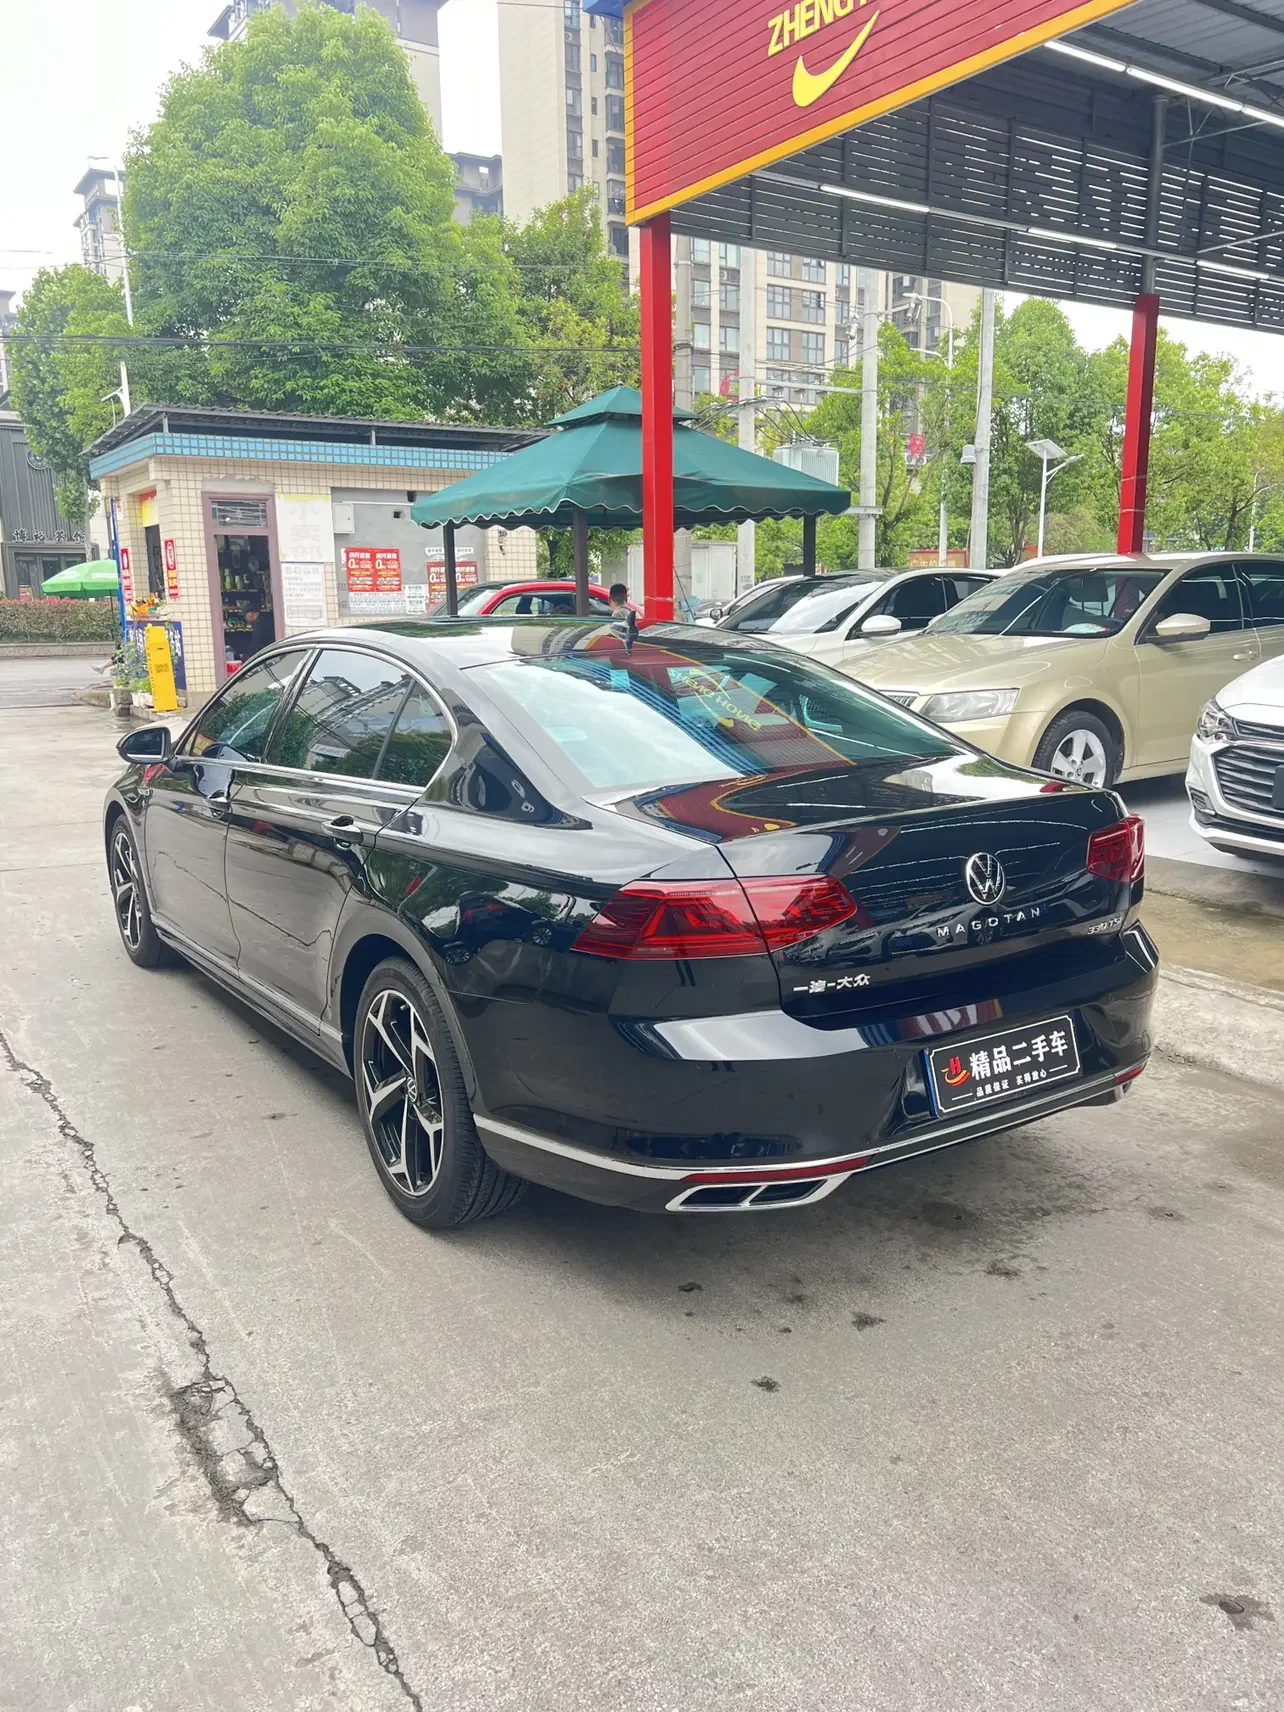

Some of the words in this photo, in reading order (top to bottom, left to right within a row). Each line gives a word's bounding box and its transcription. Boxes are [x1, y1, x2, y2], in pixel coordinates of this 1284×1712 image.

[937, 907, 1040, 938] MAGOTAN
[969, 1030, 1069, 1081] 精品二手车
[976, 1079, 1010, 1098] 品质保证
[1015, 1068, 1048, 1086] 买得放心
